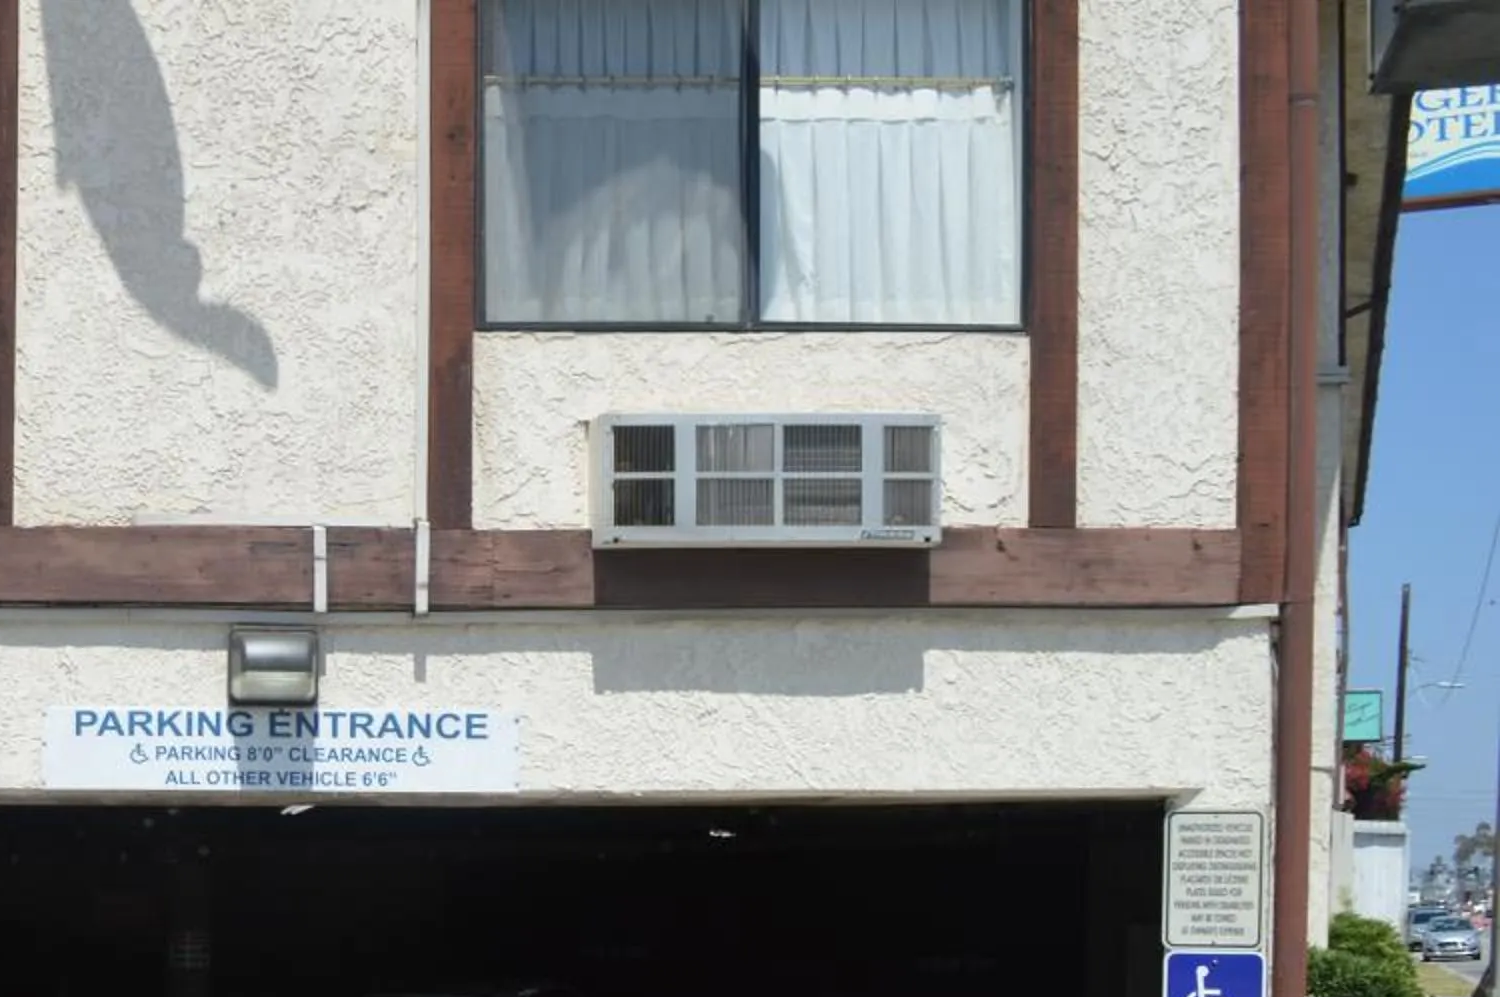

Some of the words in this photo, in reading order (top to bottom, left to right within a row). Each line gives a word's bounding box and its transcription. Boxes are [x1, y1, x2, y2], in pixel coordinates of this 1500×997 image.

[75, 711, 253, 737] PARKING
[269, 711, 488, 739] ENTRANCE
[155, 745, 241, 761] PARKING
[289, 747, 407, 763] CLEARANCE
[165, 770, 200, 785] ALL
[206, 770, 270, 786] OTHER
[276, 771, 357, 786] VEHICLE
